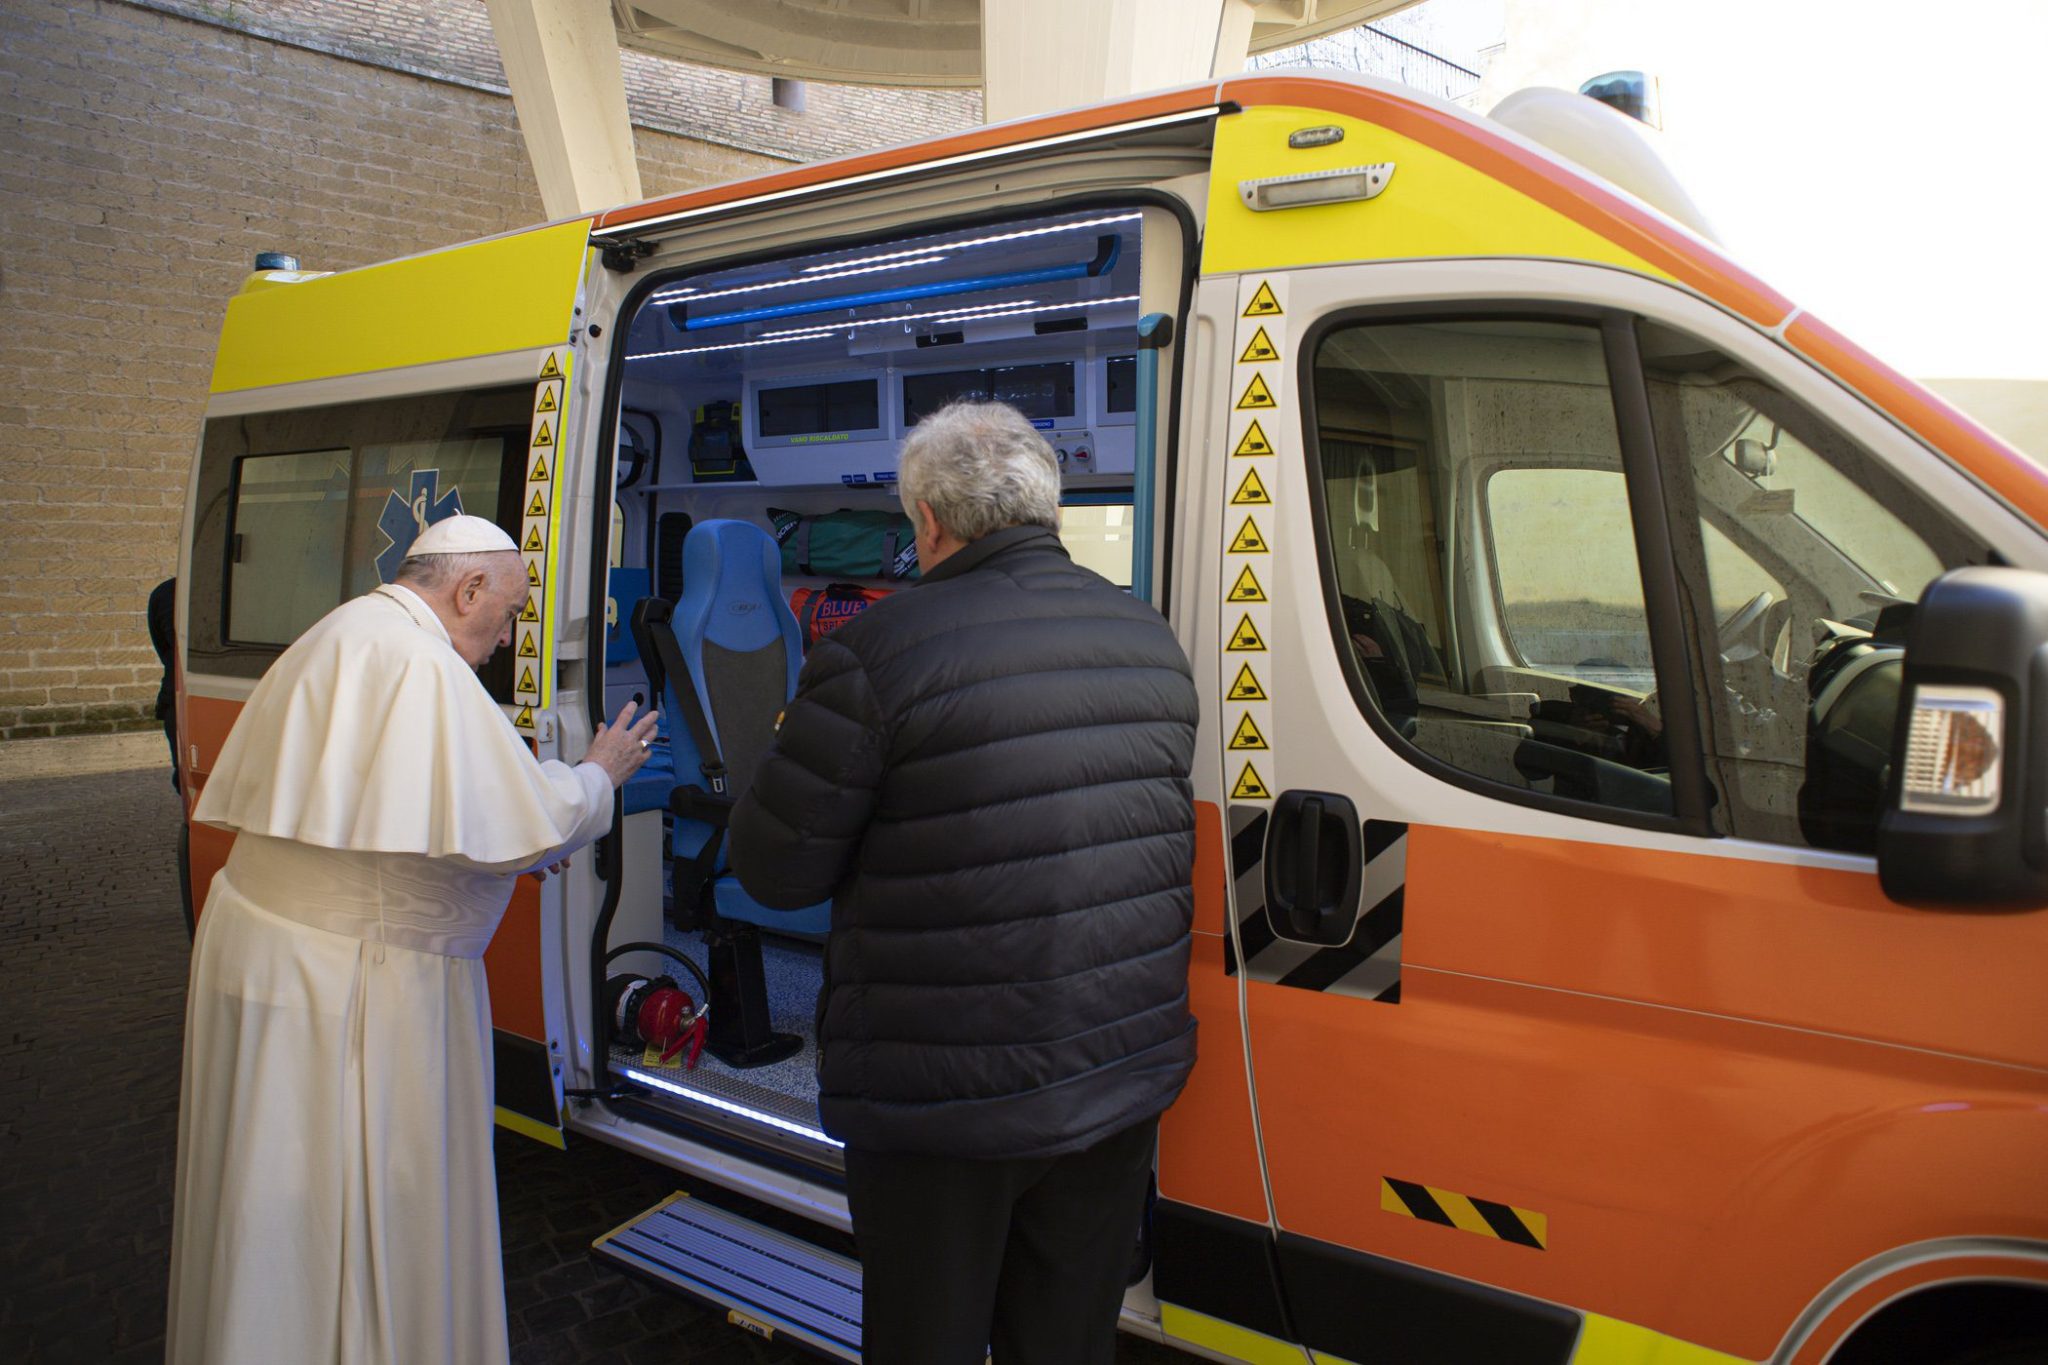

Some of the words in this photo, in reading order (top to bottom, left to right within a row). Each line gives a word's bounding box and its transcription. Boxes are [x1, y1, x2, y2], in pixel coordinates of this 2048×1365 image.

[790, 435, 807, 443] VANO
[809, 433, 849, 442] RISCALDATO
[821, 600, 862, 616] BLUE
